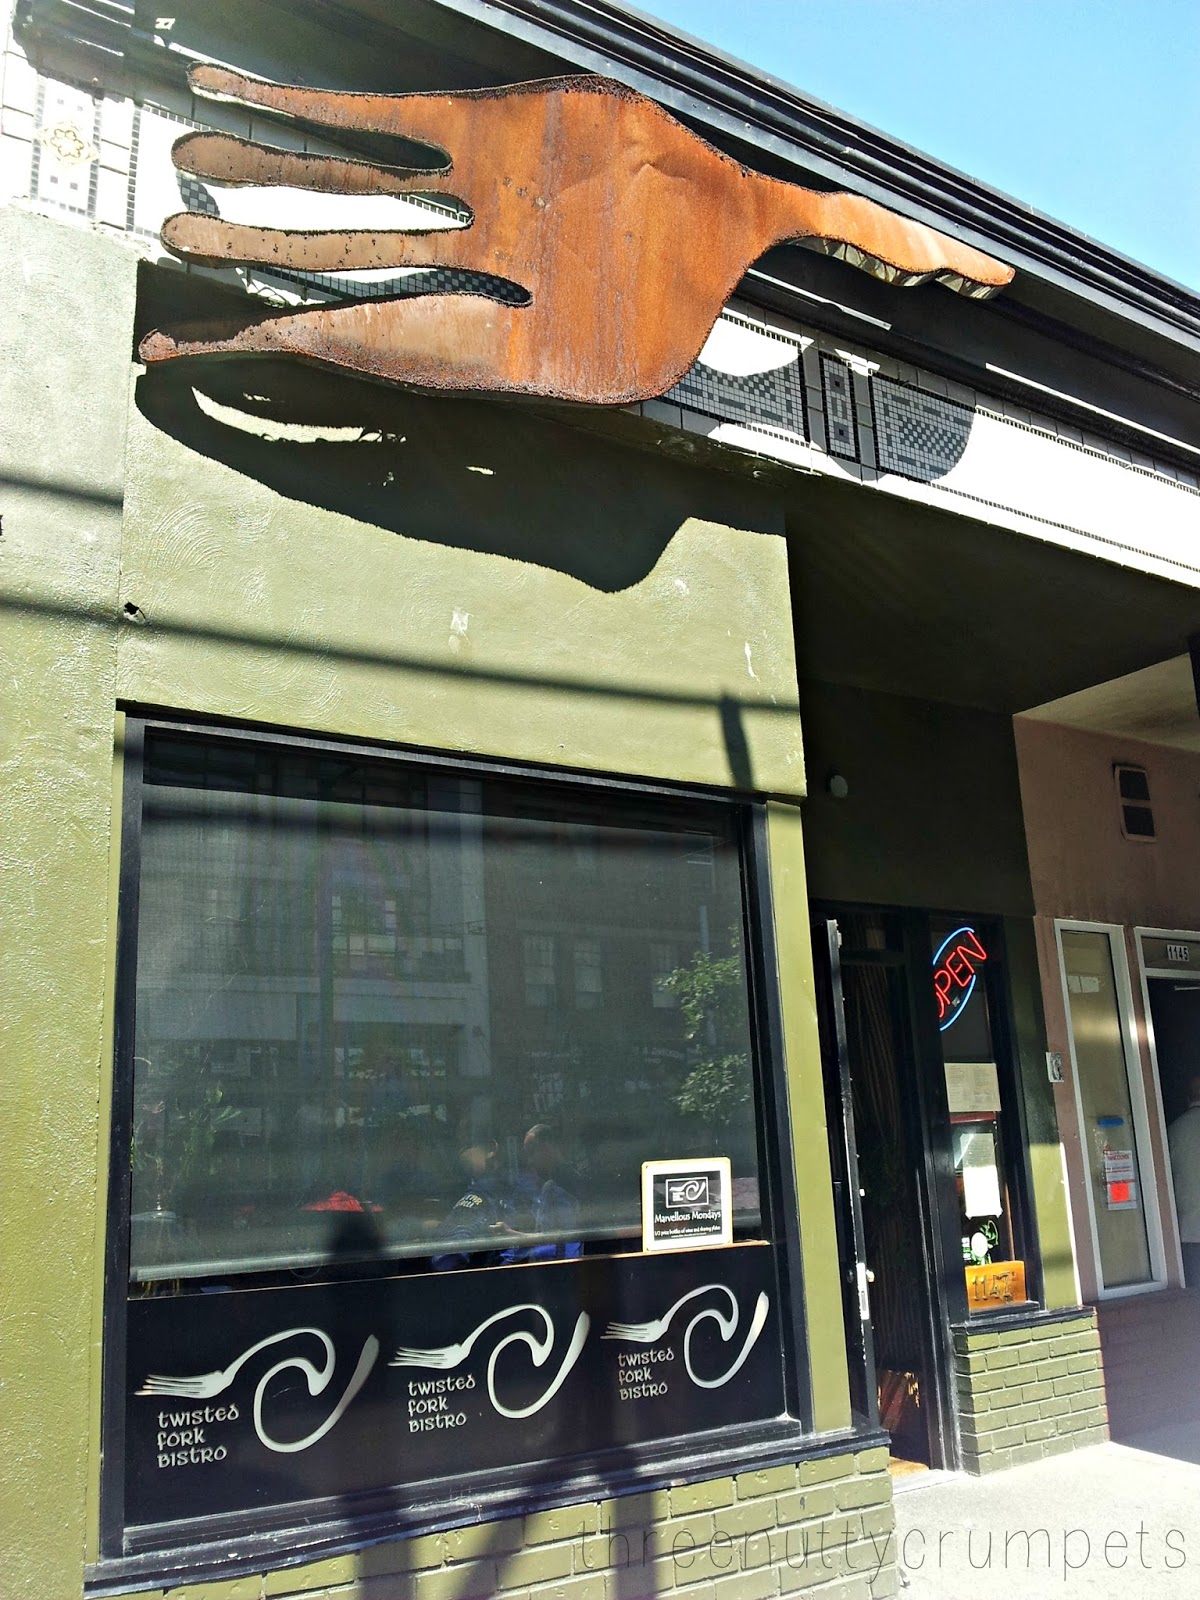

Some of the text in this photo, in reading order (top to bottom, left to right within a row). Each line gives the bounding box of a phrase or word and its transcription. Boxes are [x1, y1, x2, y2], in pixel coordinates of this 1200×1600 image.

[1168, 945, 1189, 961] 1145
[654, 1209, 721, 1224] Marvellous Mondays
